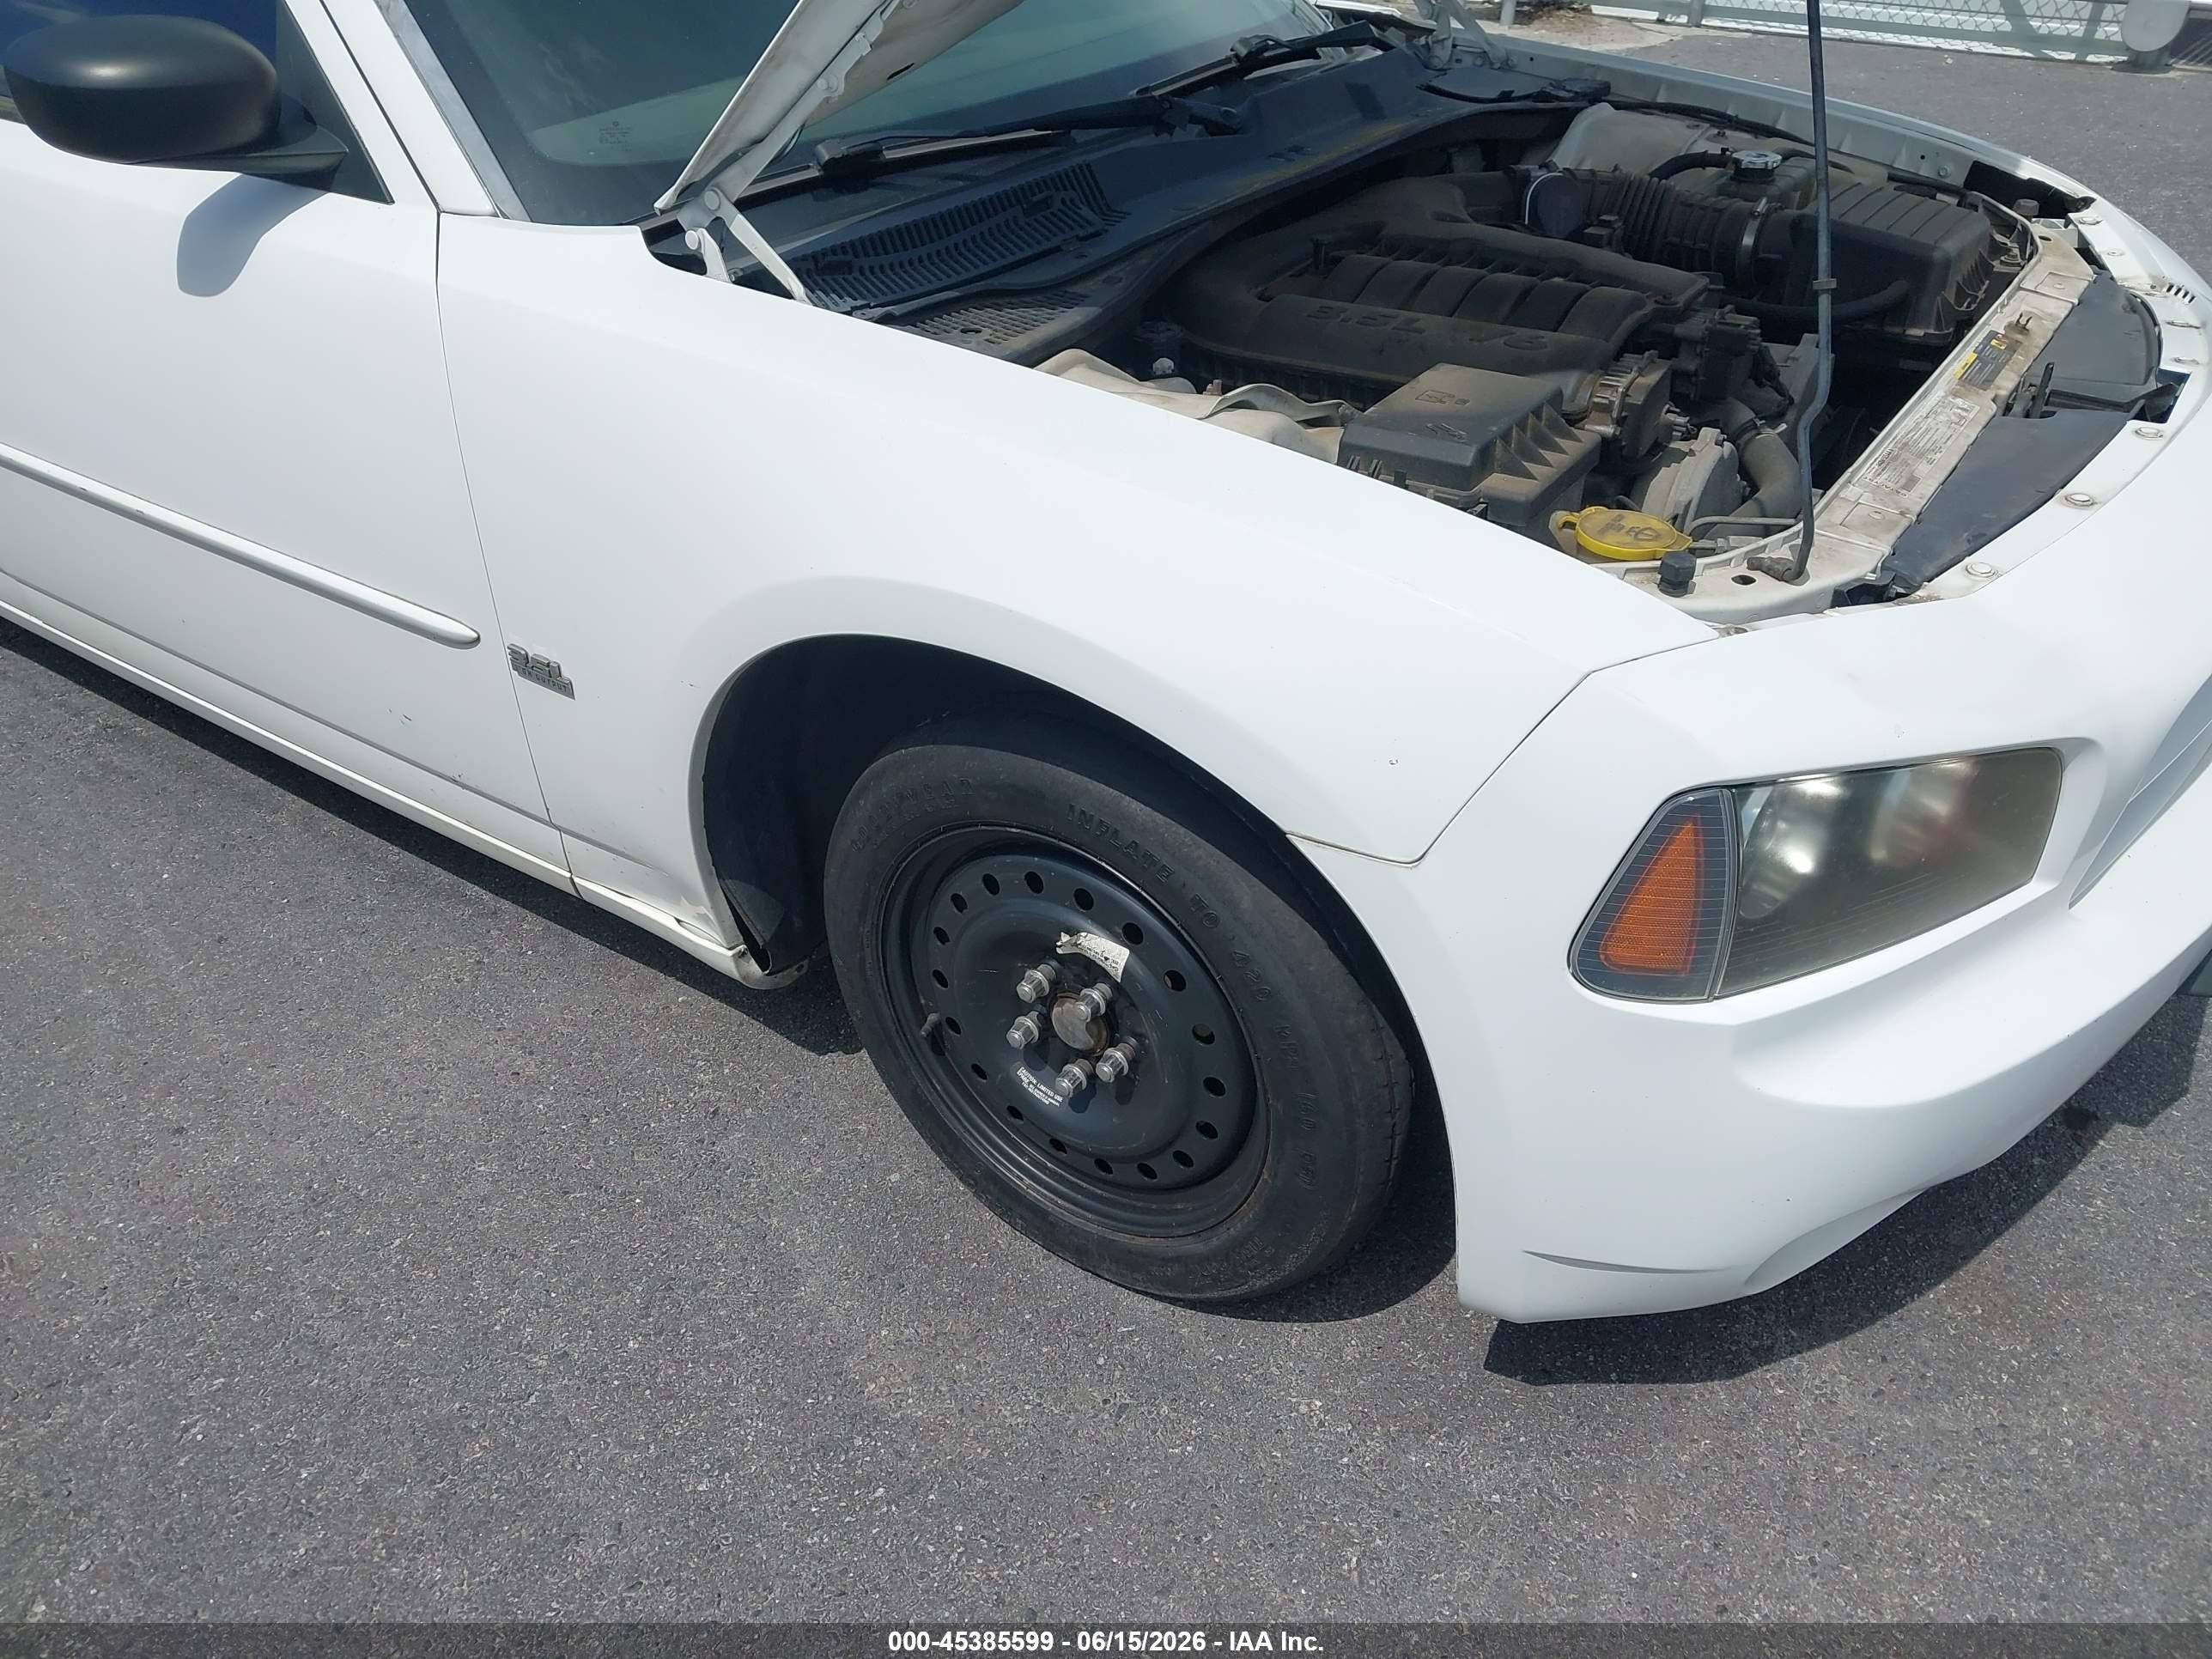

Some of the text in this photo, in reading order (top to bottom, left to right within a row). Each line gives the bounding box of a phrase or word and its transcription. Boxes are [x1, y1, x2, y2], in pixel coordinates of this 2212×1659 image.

[1067, 803, 1176, 884] INFLATE
[1188, 893, 1222, 929] TO
[1231, 949, 1273, 1002] 420
